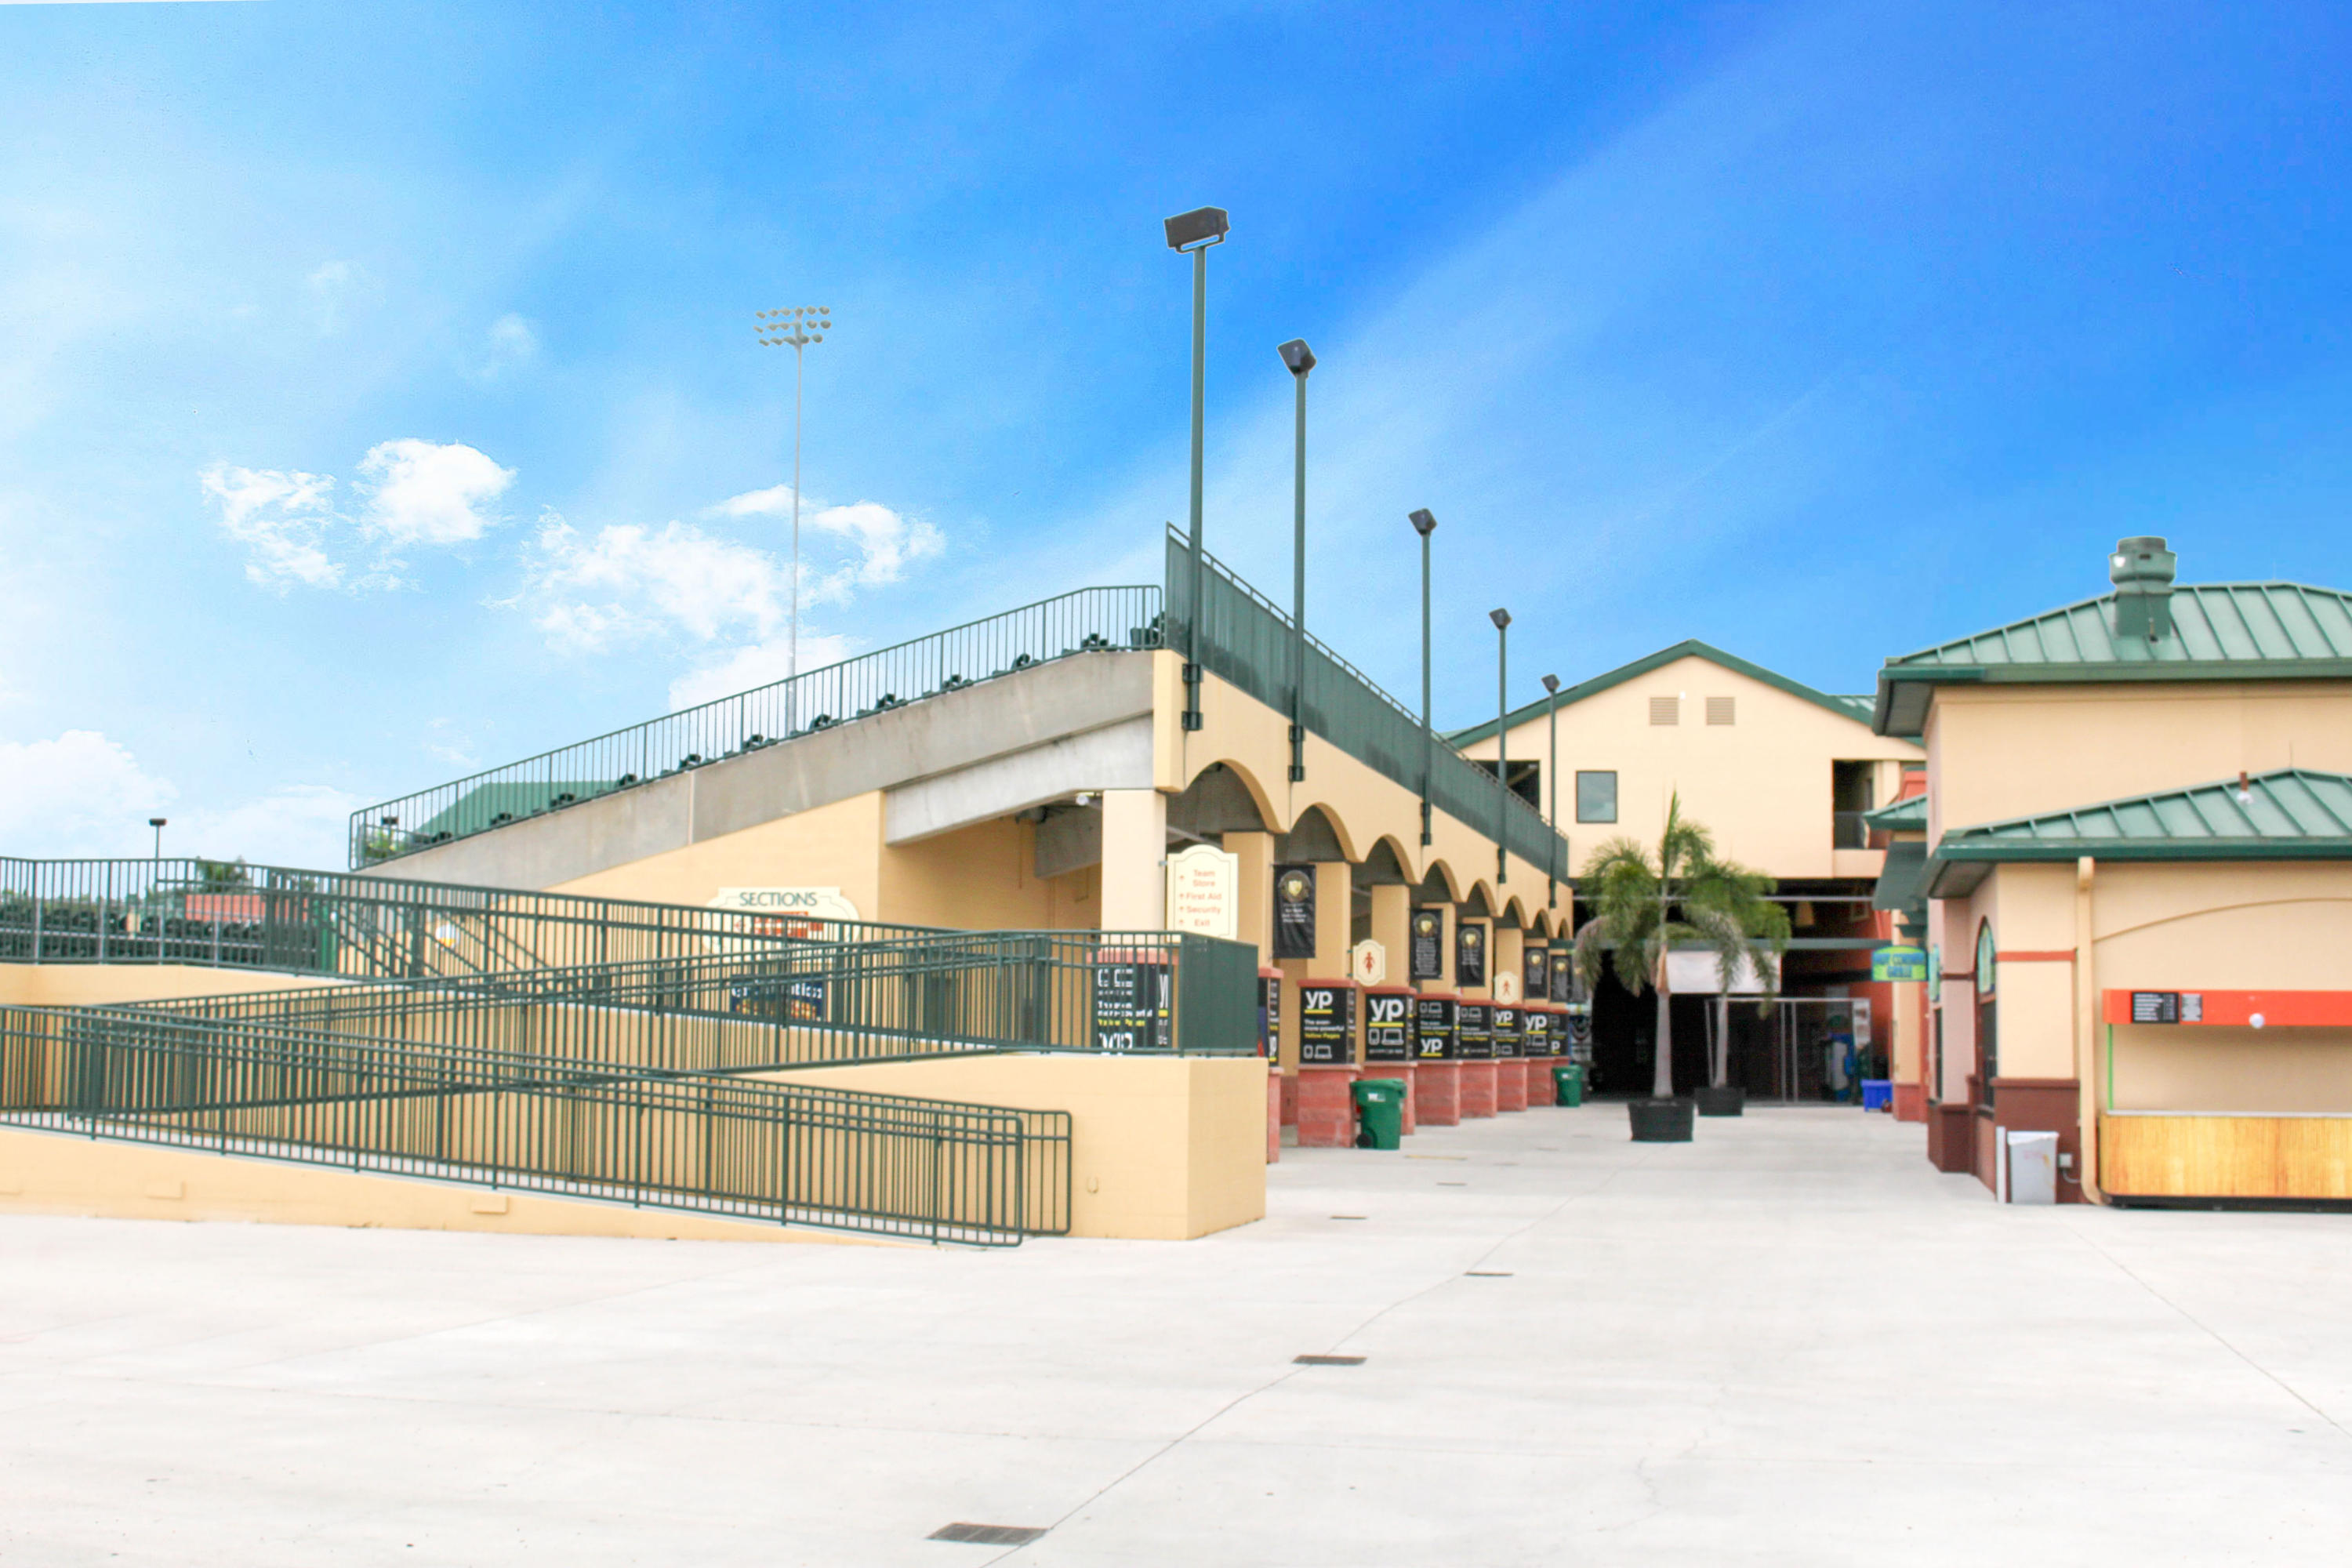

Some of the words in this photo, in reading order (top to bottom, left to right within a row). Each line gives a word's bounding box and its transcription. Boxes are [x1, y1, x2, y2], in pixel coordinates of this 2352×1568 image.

[1193, 869, 1215, 877] Team
[1192, 879, 1215, 887] Store
[739, 891, 818, 907] SECTIONS
[1186, 906, 1221, 916] Security
[1305, 990, 1333, 1009] yp
[1370, 998, 1404, 1022] yp
[1495, 1010, 1513, 1022] yp
[1525, 1014, 1548, 1030] yp
[1420, 1037, 1443, 1053] yp
